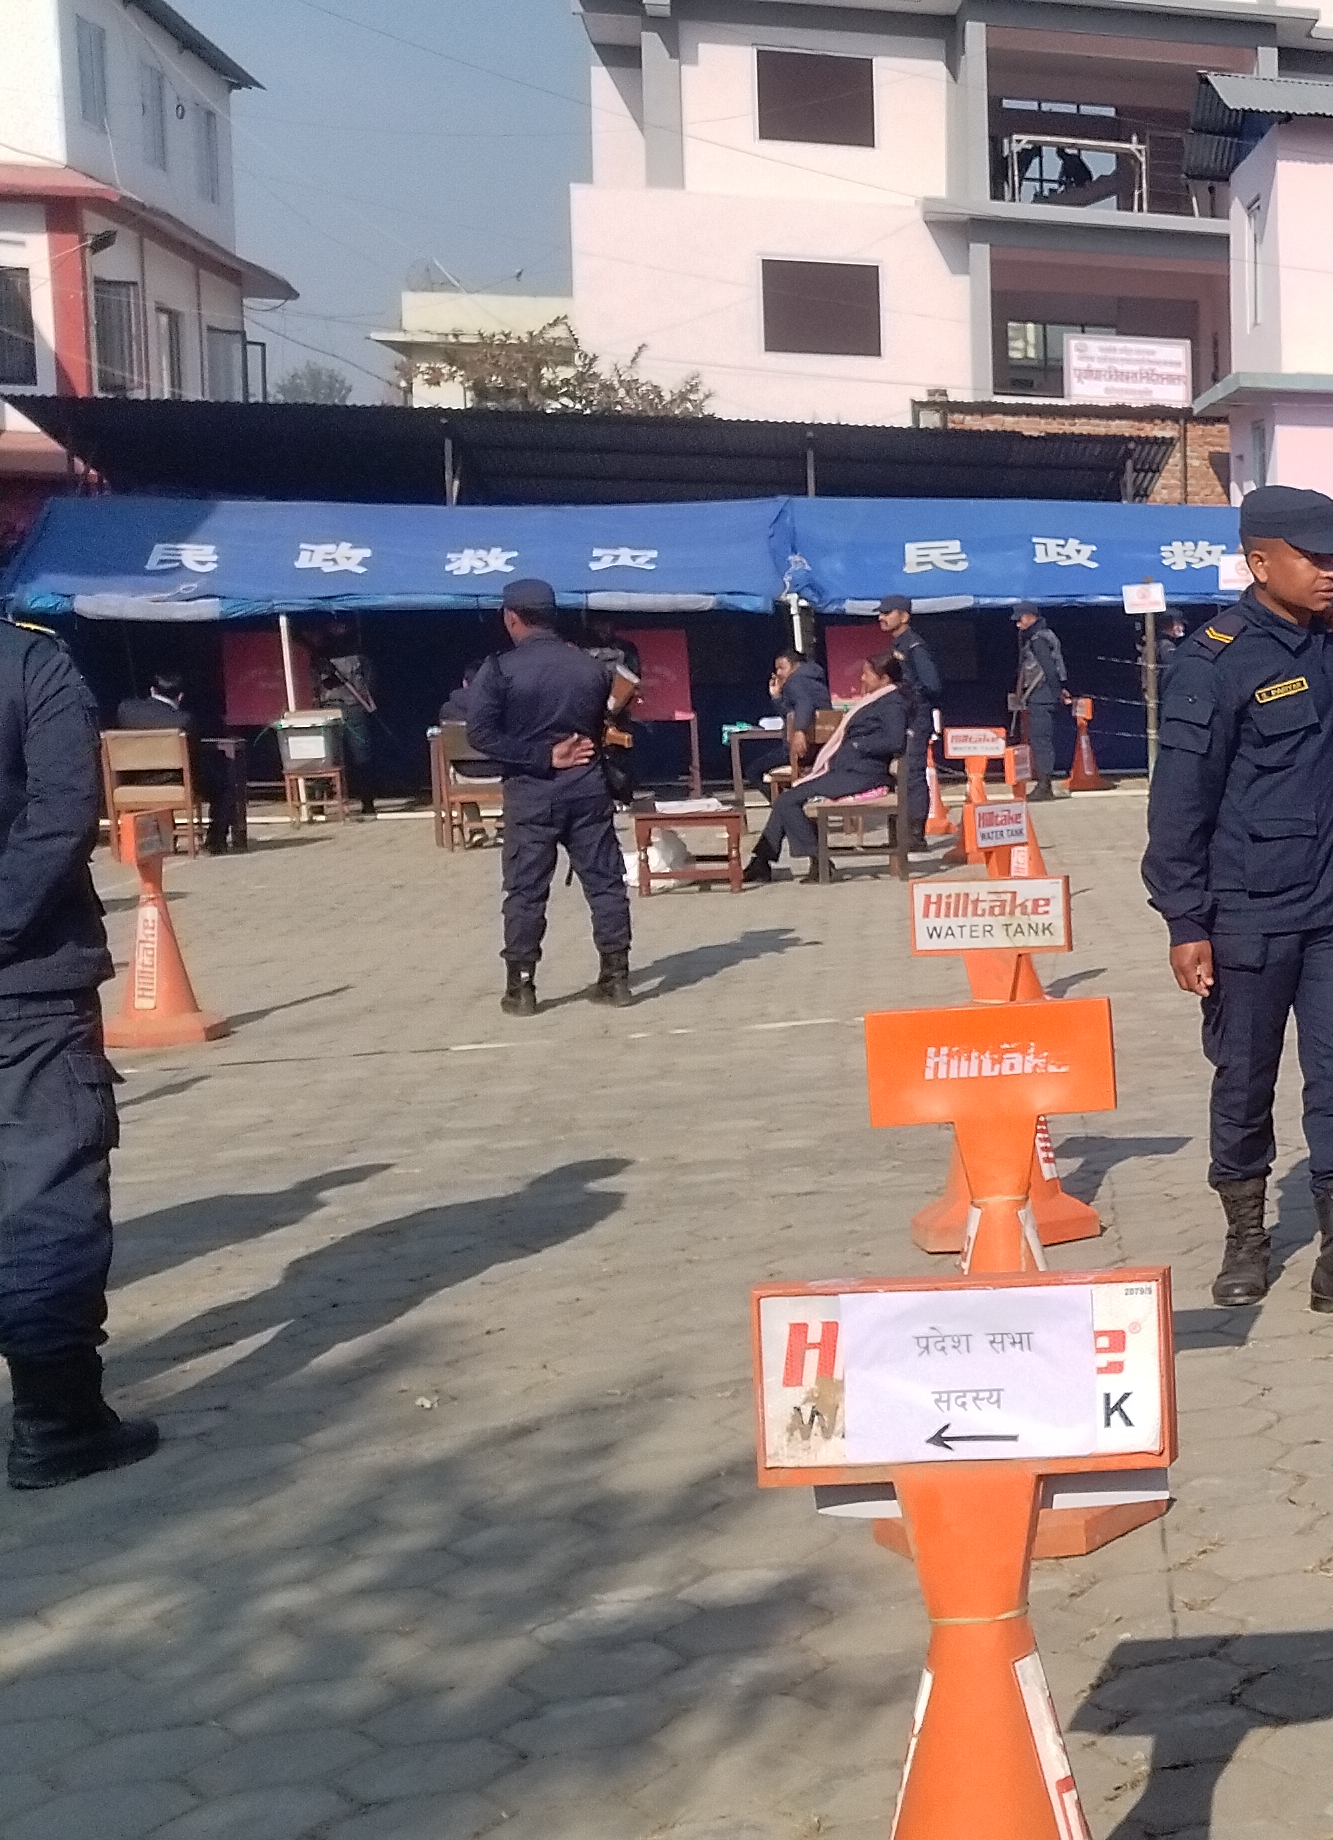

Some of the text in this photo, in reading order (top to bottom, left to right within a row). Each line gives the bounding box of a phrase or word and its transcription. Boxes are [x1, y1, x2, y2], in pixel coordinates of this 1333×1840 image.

[145, 542, 658, 575] 民政救灾
[978, 809, 1022, 829] Hilltake
[980, 828, 1025, 841] WATER TANK
[922, 891, 1051, 919] Hilltake
[926, 922, 1055, 940] WATER TANK
[913, 1326, 1034, 1357] प्रदेश सभा
[930, 1388, 1004, 1412] सदस्य
